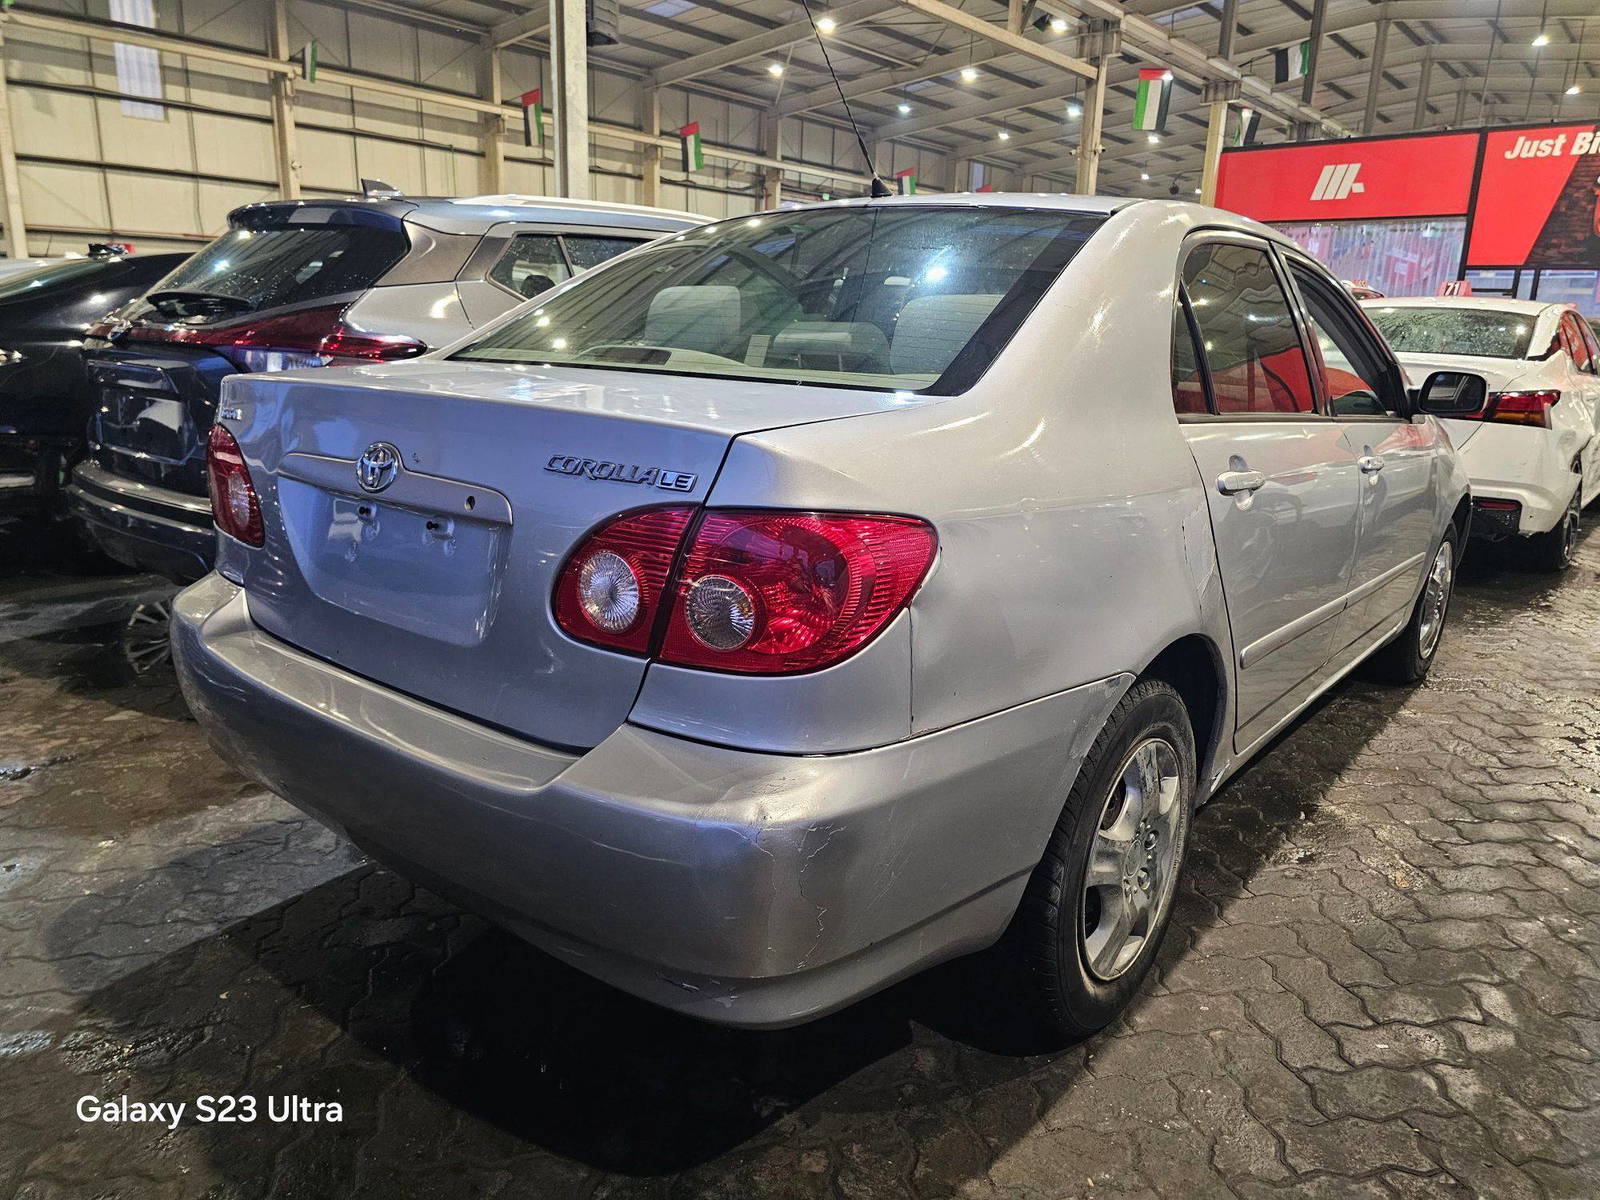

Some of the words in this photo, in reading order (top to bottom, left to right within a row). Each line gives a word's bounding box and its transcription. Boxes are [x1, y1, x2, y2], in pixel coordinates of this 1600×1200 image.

[1504, 133, 1567, 159] Just
[1569, 130, 1600, 155] Bi
[1444, 282, 1460, 296] 71
